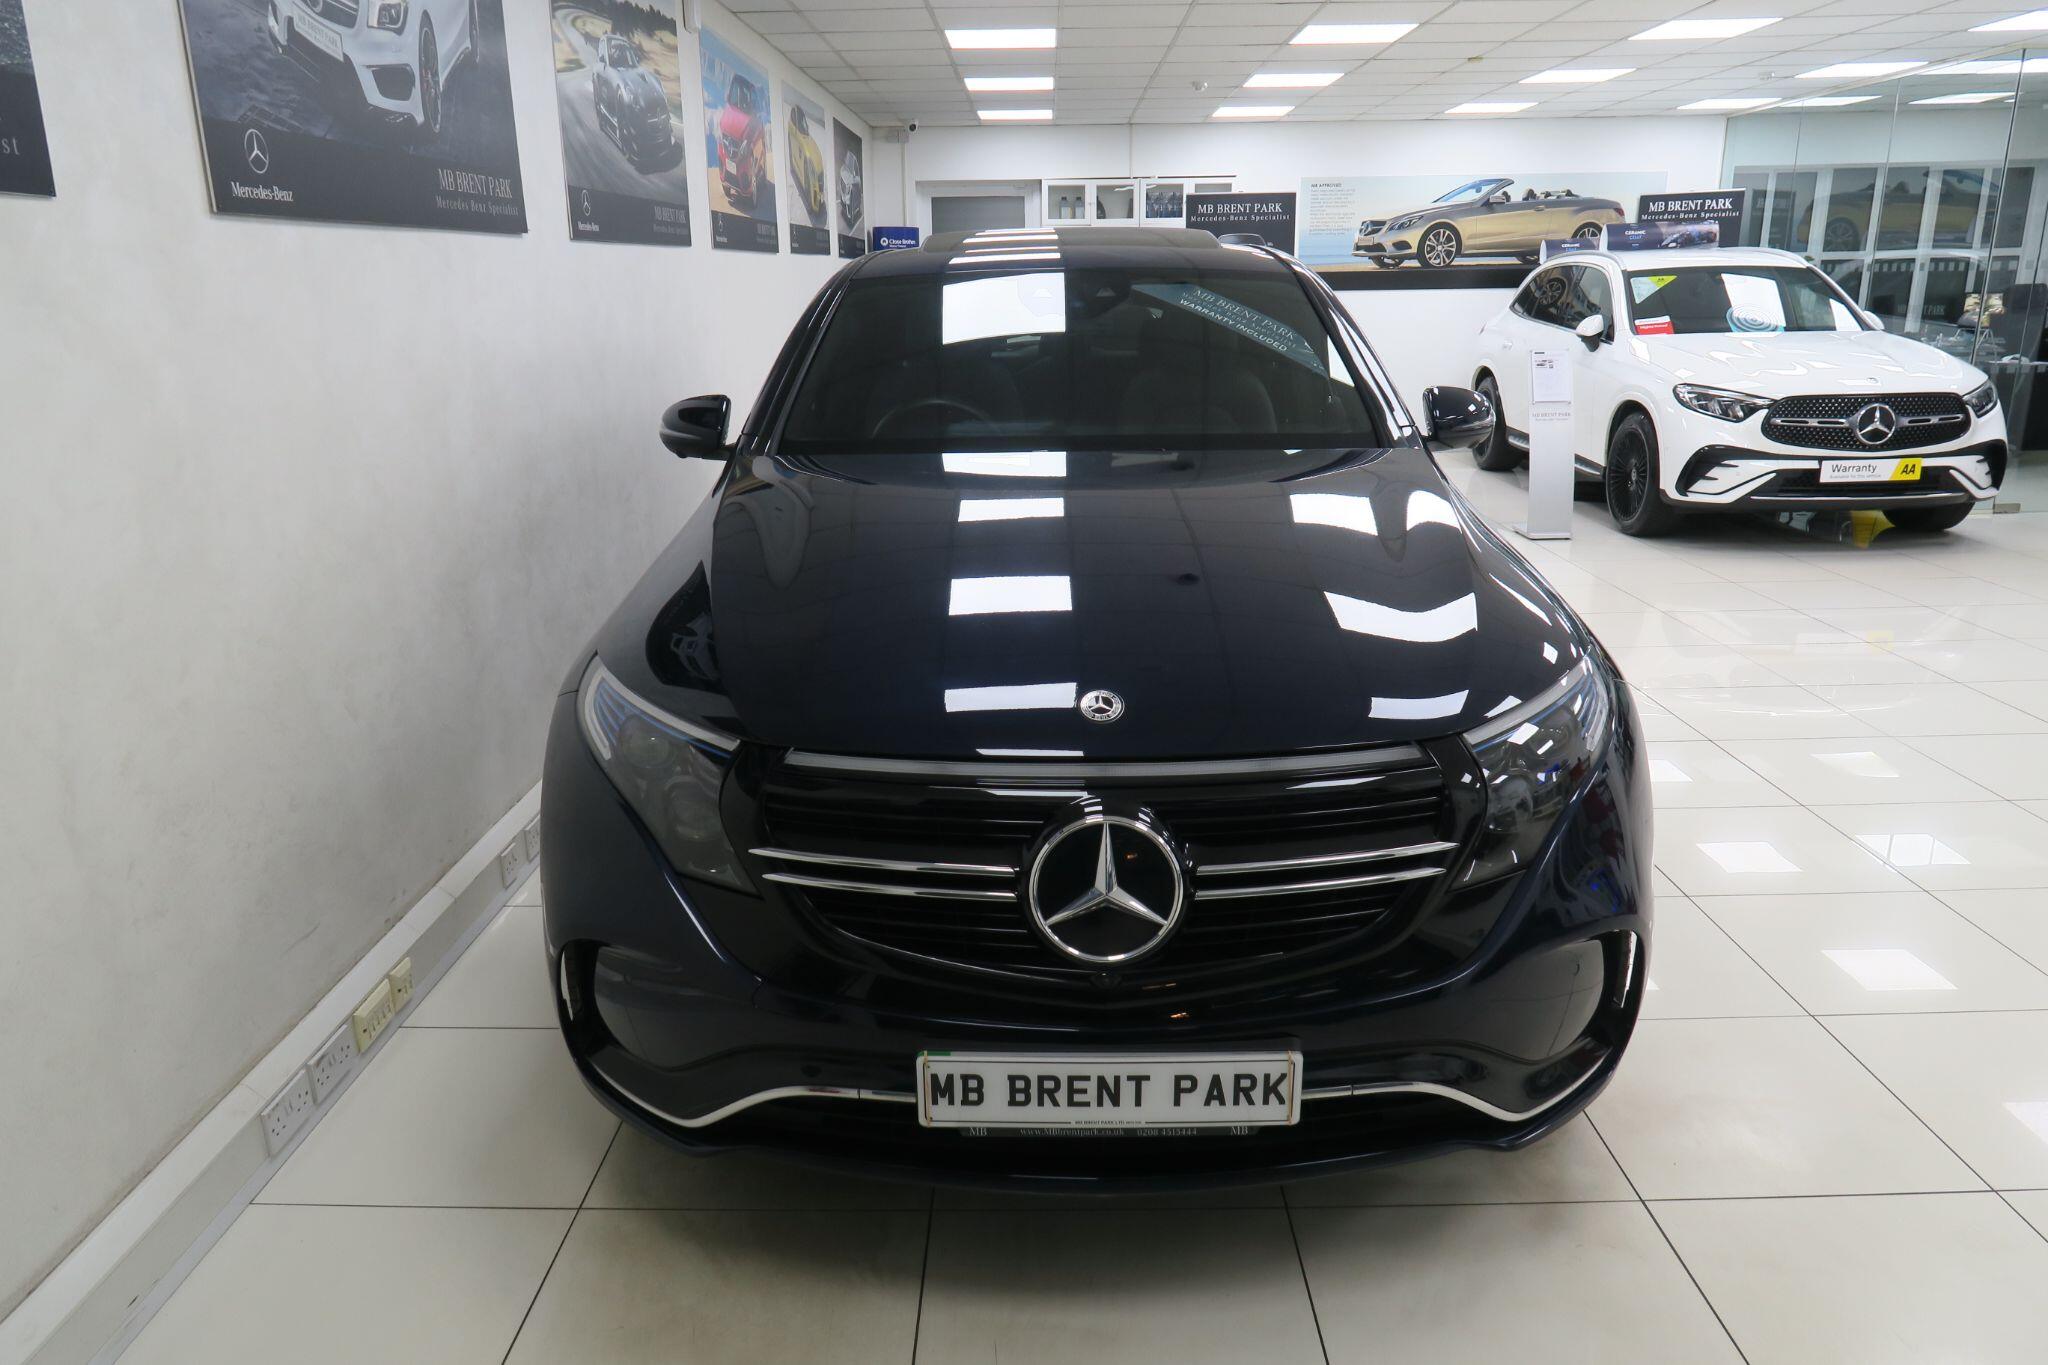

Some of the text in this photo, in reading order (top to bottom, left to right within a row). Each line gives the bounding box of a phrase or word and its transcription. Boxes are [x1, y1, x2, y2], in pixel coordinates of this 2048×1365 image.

[231, 181, 294, 202] Mercedes-Benz
[438, 168, 513, 199] MB BRENT PARK
[436, 195, 519, 217] Mercedes Benz Specialist
[1197, 202, 1282, 214] MB BRENT PARK
[1648, 198, 1733, 213] MB BRENT PARK
[1251, 214, 1290, 222] Specialist
[1641, 211, 1740, 220] Mercedes-Benz Specialist
[1193, 289, 1297, 340] MB BRENT PARK
[1180, 298, 1288, 351] WARRANTY INCLUDED
[1831, 463, 1916, 475] Warranty AA
[930, 1072, 1288, 1108] MB BRENT PARK
[969, 1127, 987, 1136] MB
[1230, 1126, 1248, 1136] MB
